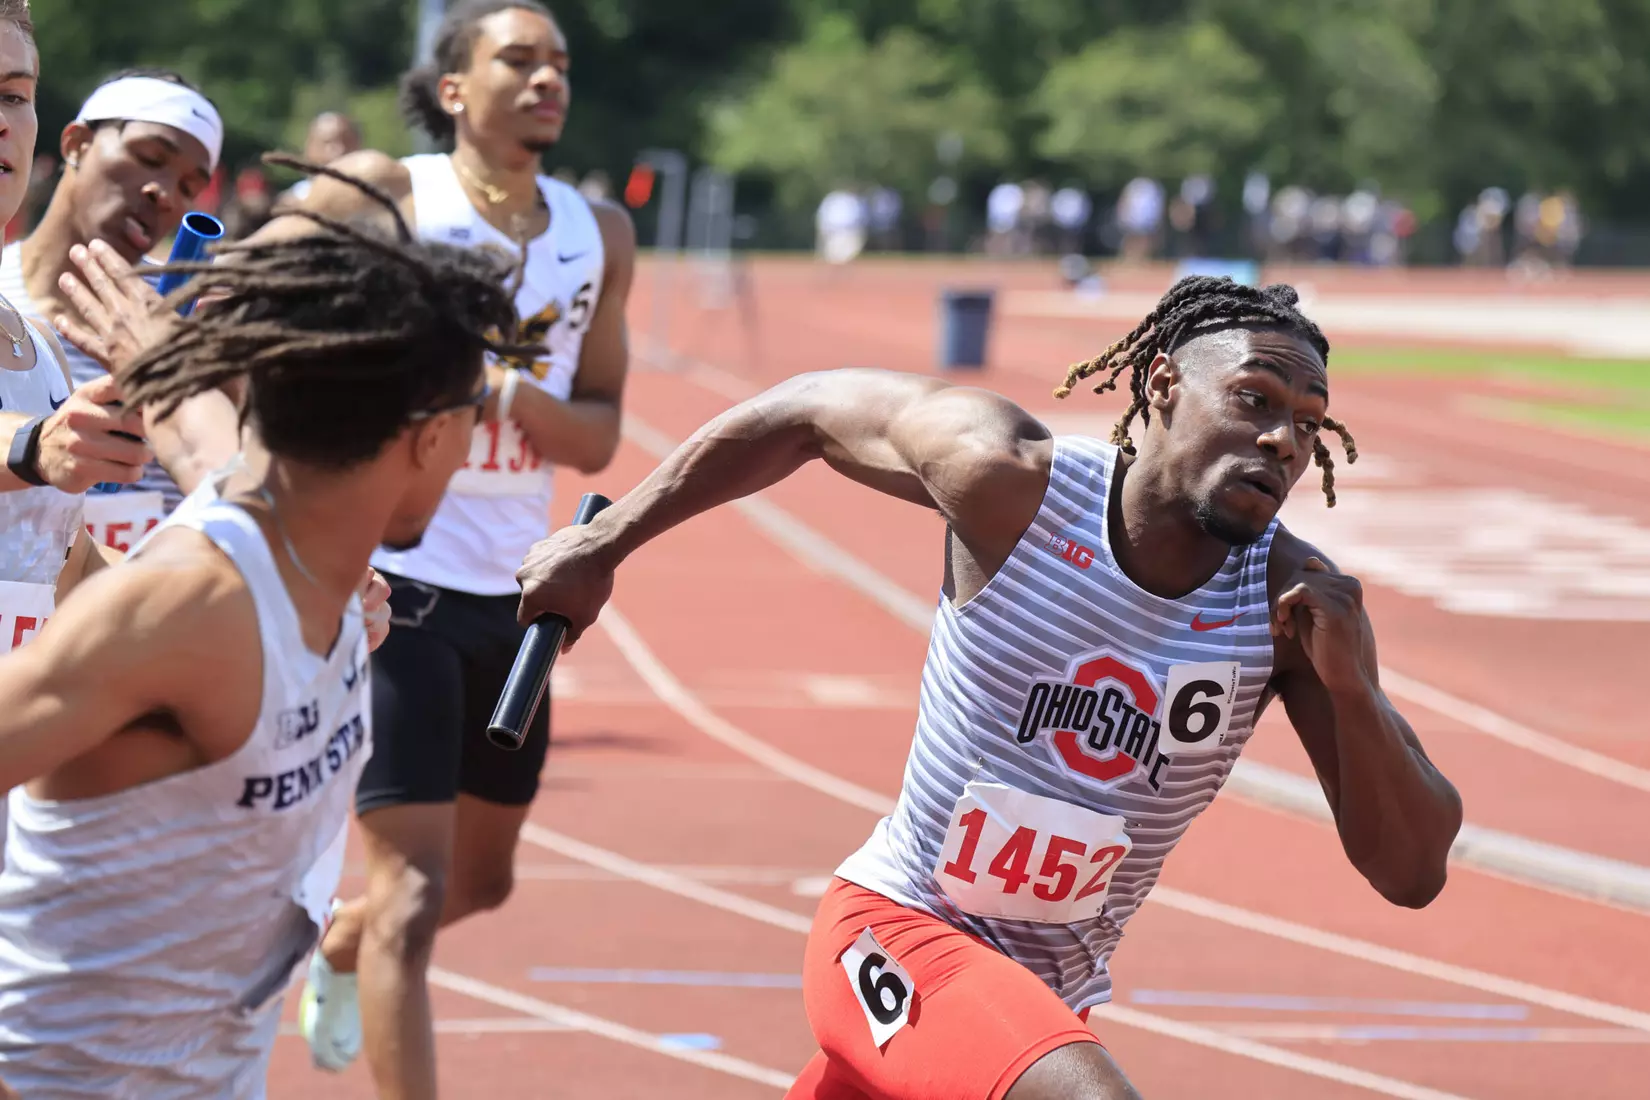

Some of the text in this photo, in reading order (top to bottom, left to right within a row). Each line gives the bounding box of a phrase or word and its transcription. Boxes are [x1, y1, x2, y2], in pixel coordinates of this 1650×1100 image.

[1168, 679, 1225, 743] 6
[944, 808, 1127, 903] 1452
[859, 952, 908, 1025] 6
